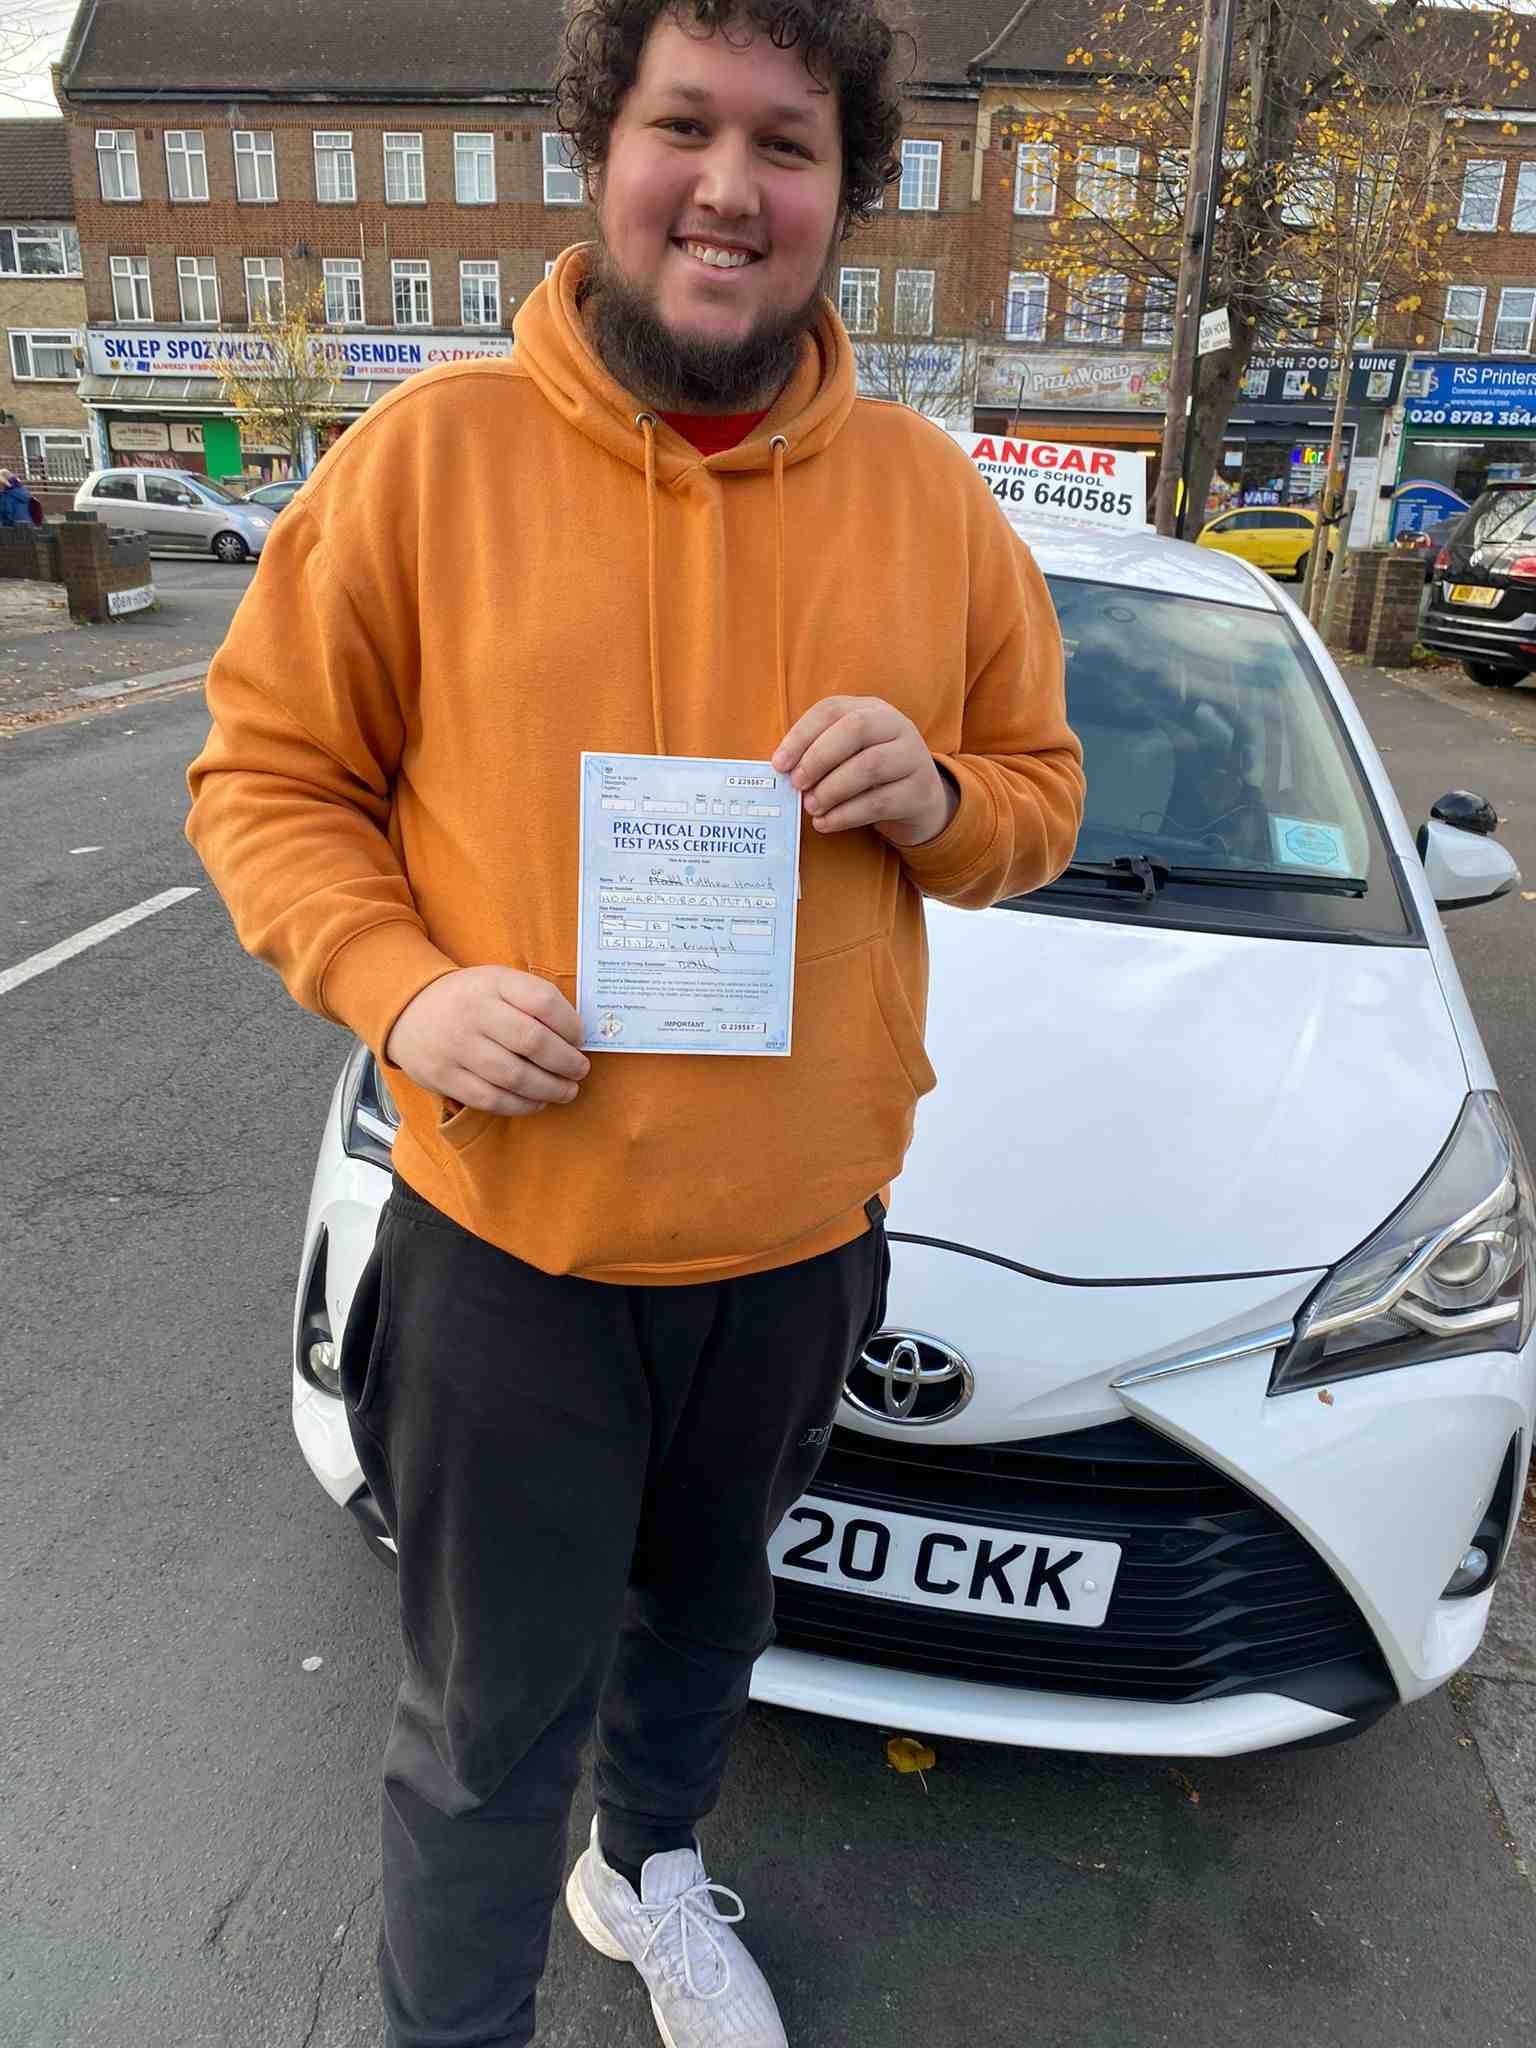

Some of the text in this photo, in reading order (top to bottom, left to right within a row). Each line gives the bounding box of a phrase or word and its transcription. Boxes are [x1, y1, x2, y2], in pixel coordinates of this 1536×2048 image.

[104, 339, 160, 358] SKLEP
[1359, 358, 1397, 371] WINE
[1076, 365, 1130, 384] WORLD
[1453, 368, 1536, 385] RS Printers
[1410, 409, 1446, 424] 020
[1450, 410, 1494, 425] 8782
[977, 463, 1104, 487] DRIVING SCHOOL
[1034, 483, 1133, 516] 640585
[1244, 490, 1280, 504] VAPE
[613, 821, 767, 841] PRACTICAL DRIVING
[613, 836, 766, 855] TEST PASS CERTIFICATE
[664, 1020, 705, 1028] IMPORTANT
[782, 1507, 1084, 1611] 20 CKK
